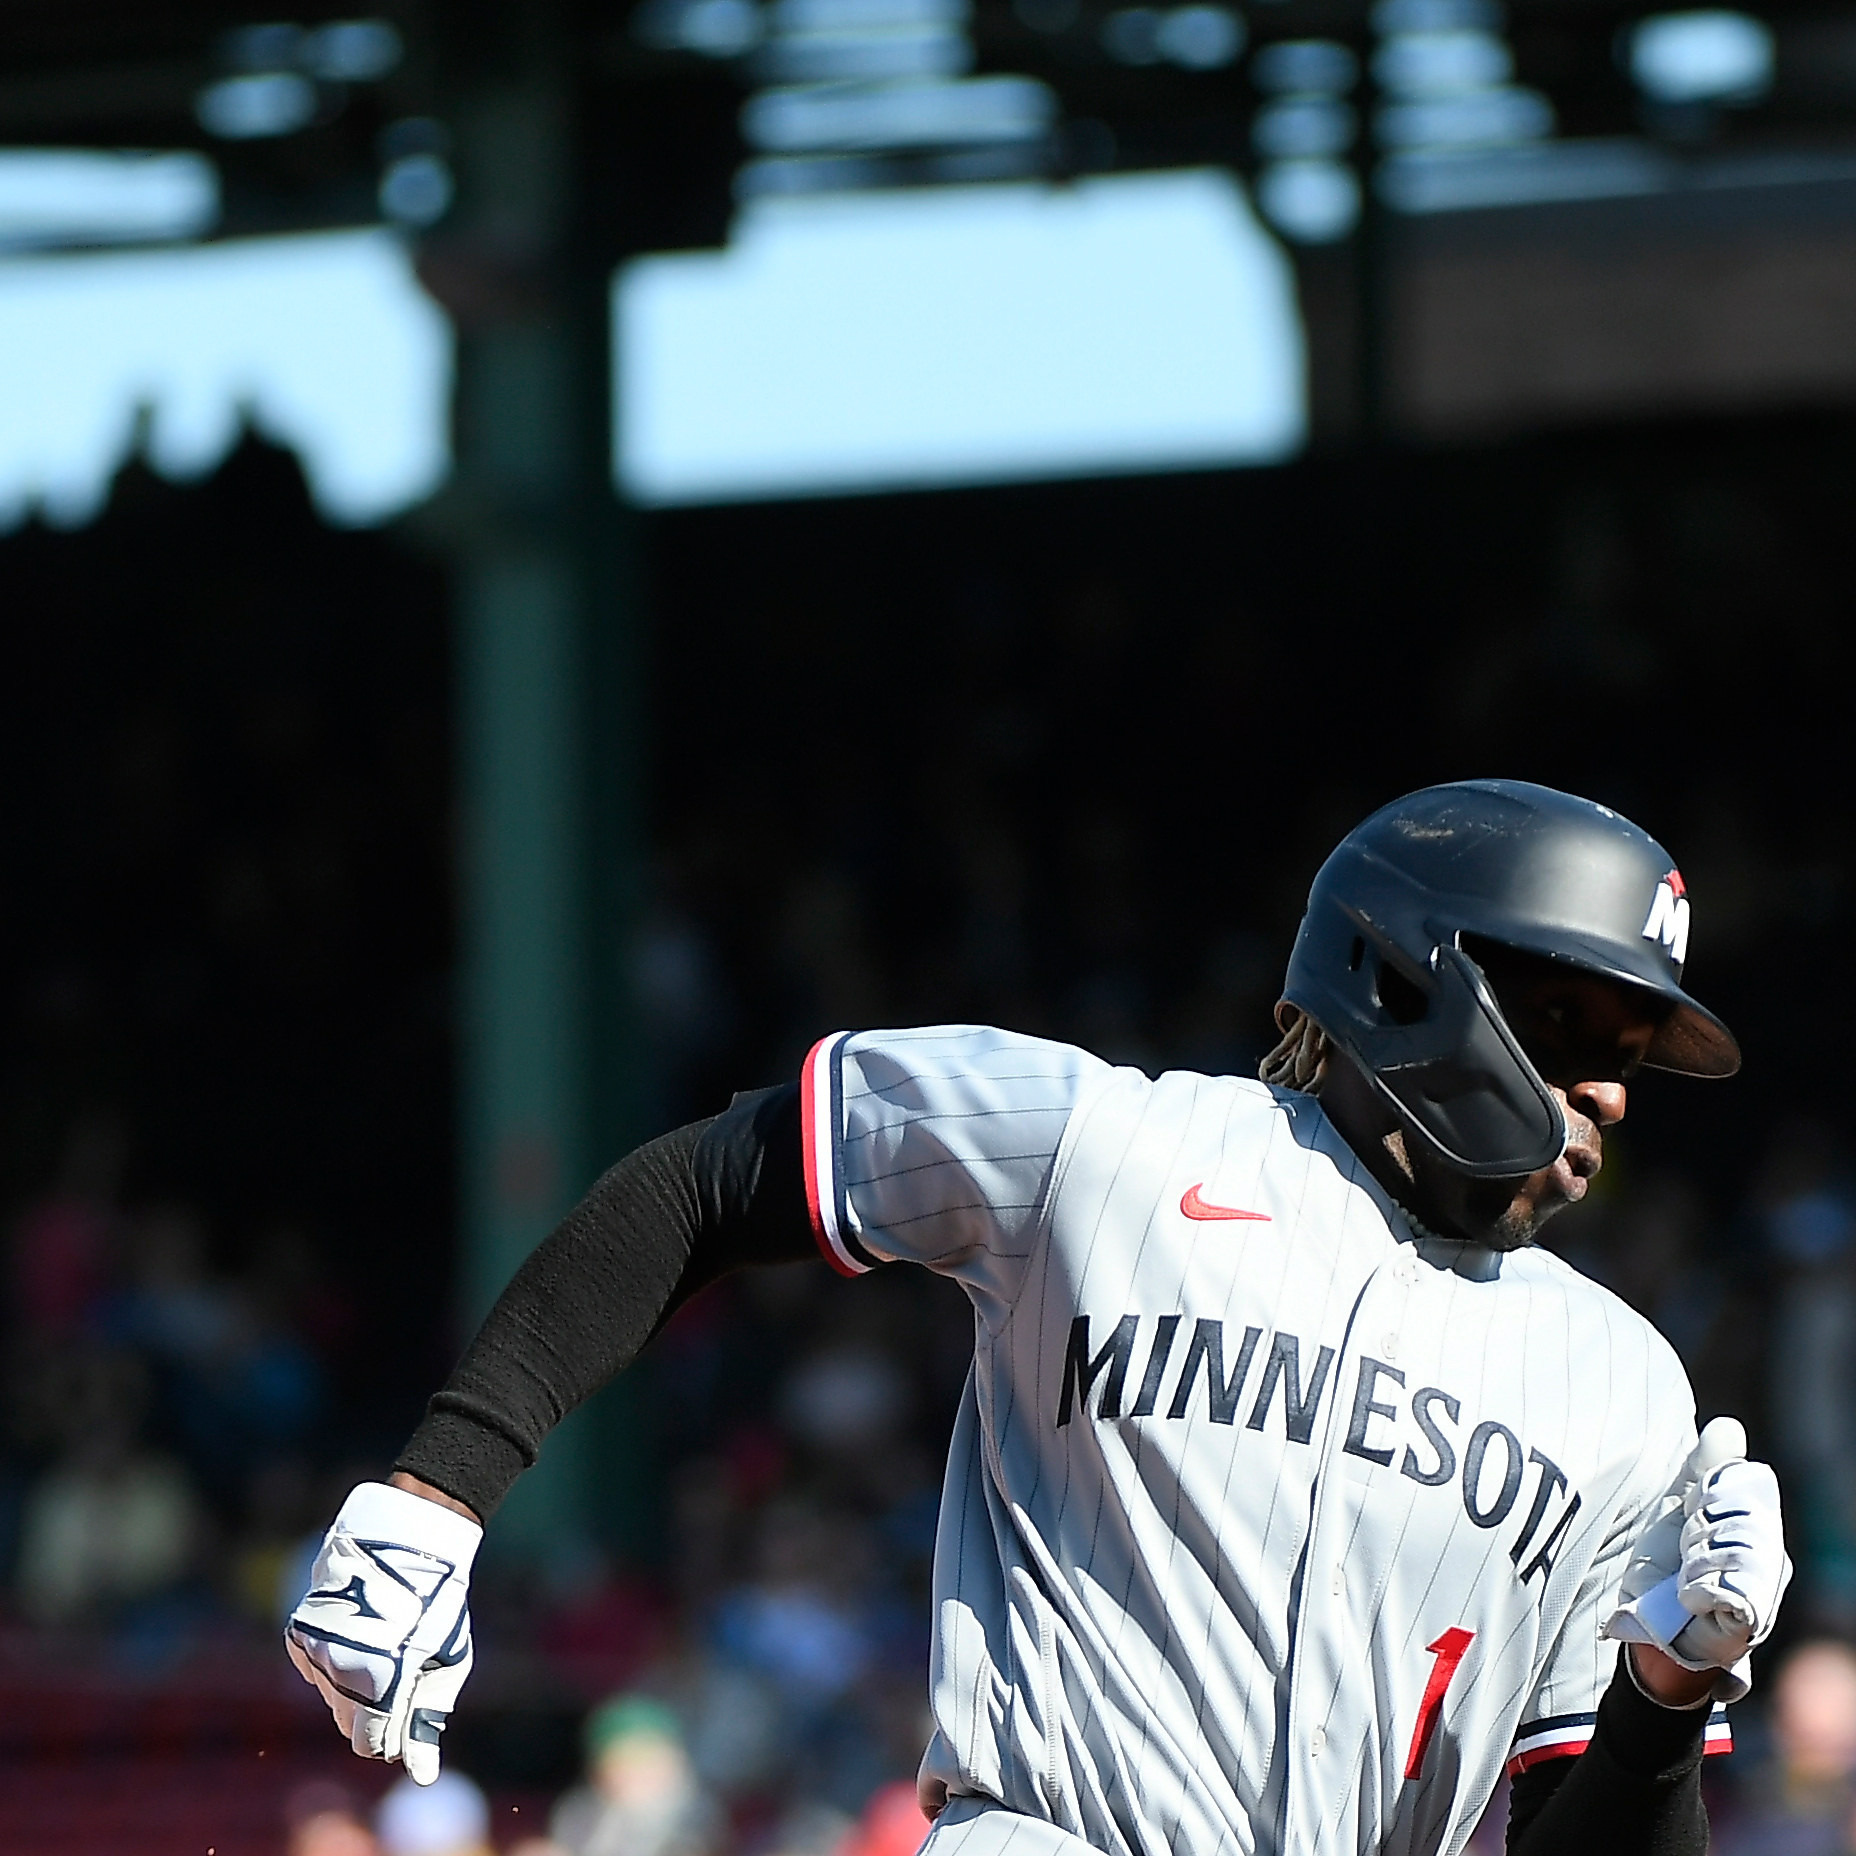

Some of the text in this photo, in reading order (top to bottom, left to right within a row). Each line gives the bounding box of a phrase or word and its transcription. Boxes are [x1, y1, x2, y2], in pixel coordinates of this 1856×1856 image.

[1641, 881, 1690, 964] M
[1057, 1314, 1582, 1588] MINNESOTA
[1404, 1626, 1477, 1780] 1
